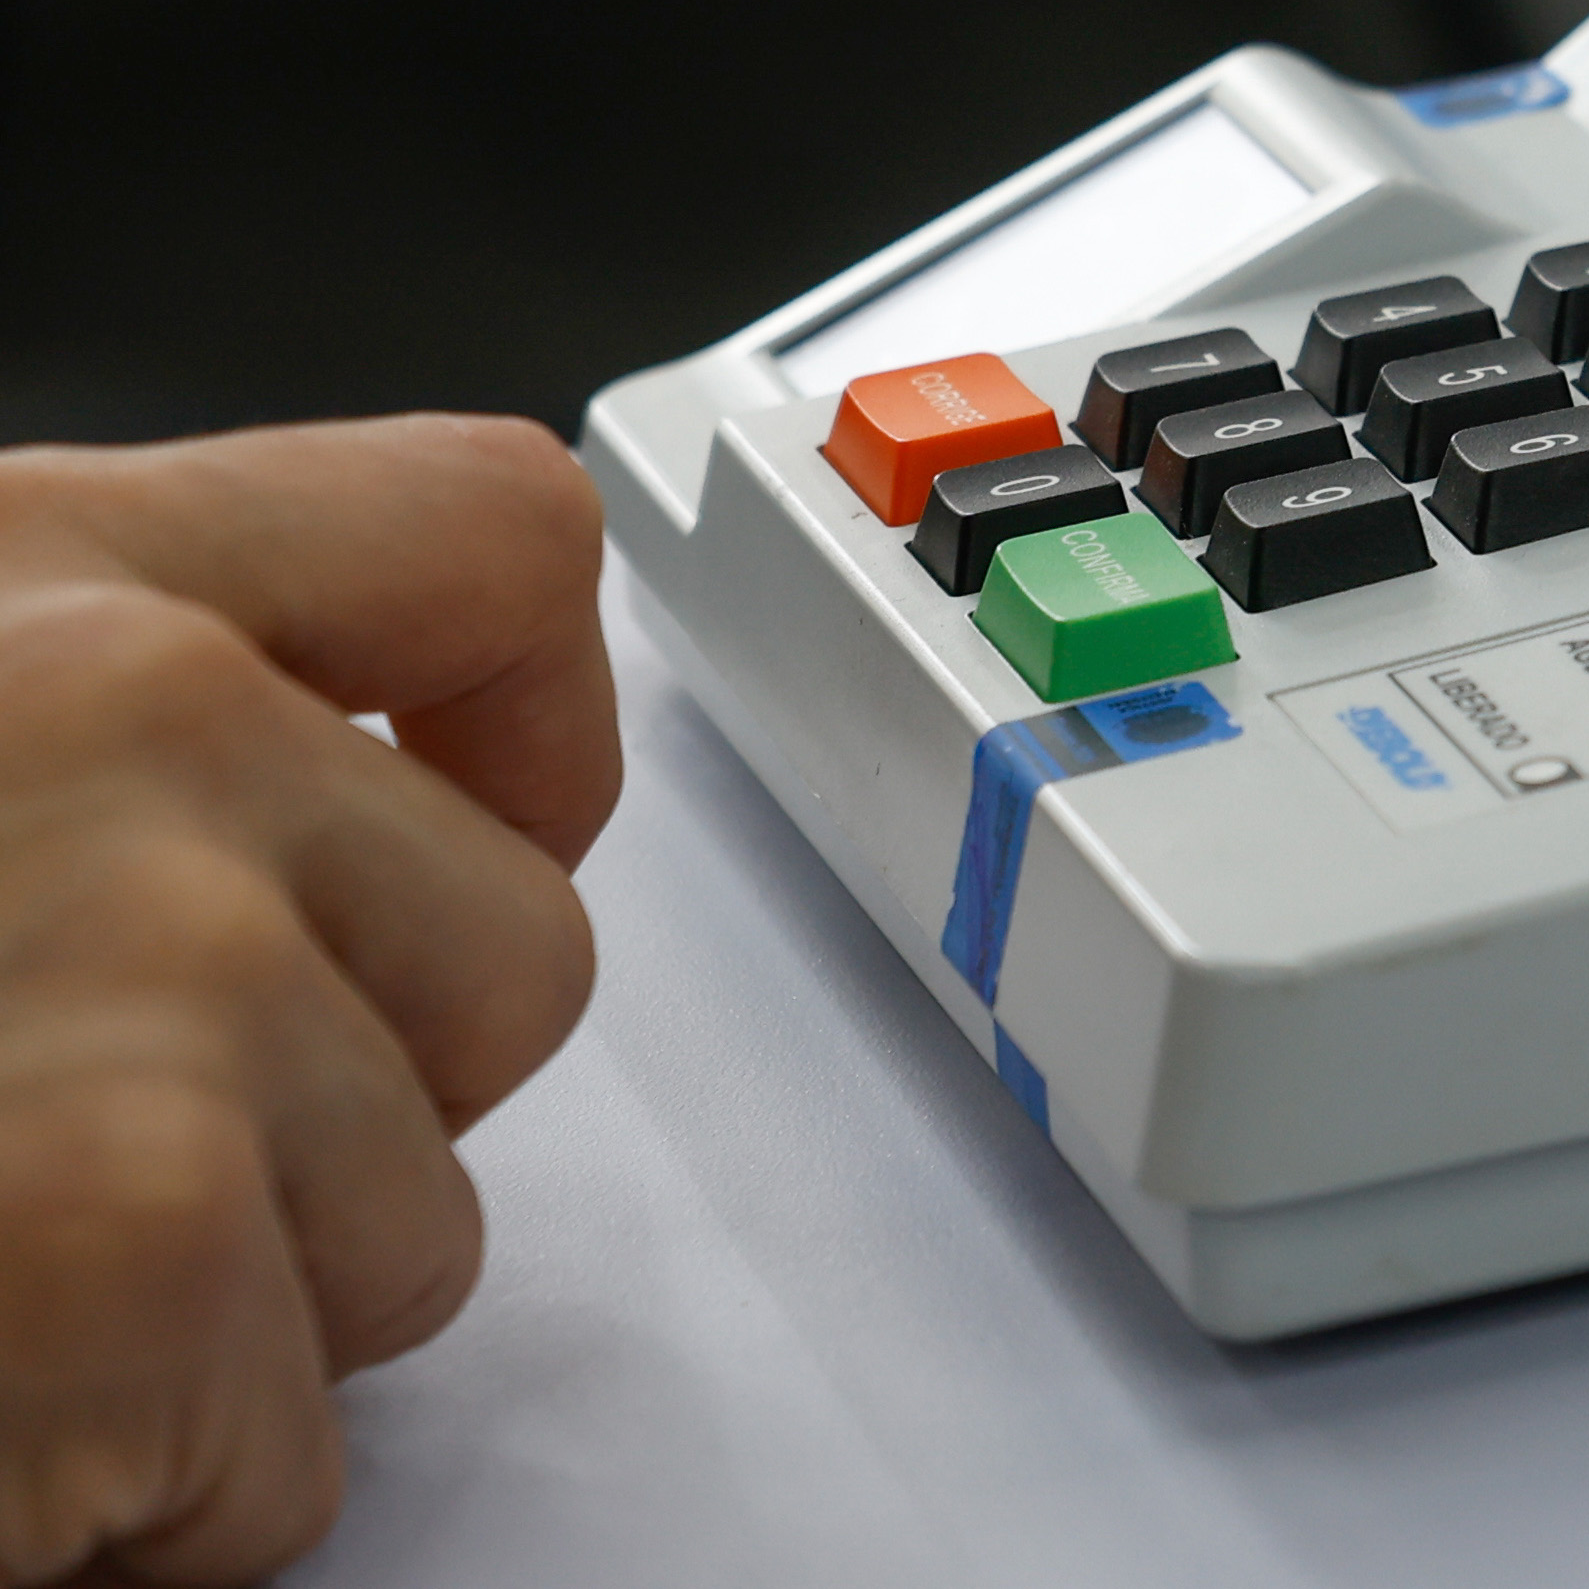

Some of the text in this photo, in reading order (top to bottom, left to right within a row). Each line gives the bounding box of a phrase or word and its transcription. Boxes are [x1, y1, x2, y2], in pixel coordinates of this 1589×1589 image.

[1373, 304, 1437, 324] 4
[1150, 353, 1221, 373] 7
[1438, 364, 1509, 386] 5
[1213, 416, 1283, 439] 8
[1509, 432, 1579, 455] 6
[990, 474, 1060, 496] 0
[1282, 485, 1352, 509] 9
[1061, 529, 1150, 604] CONFIRMA
[1428, 667, 1531, 751] LIBERADO
